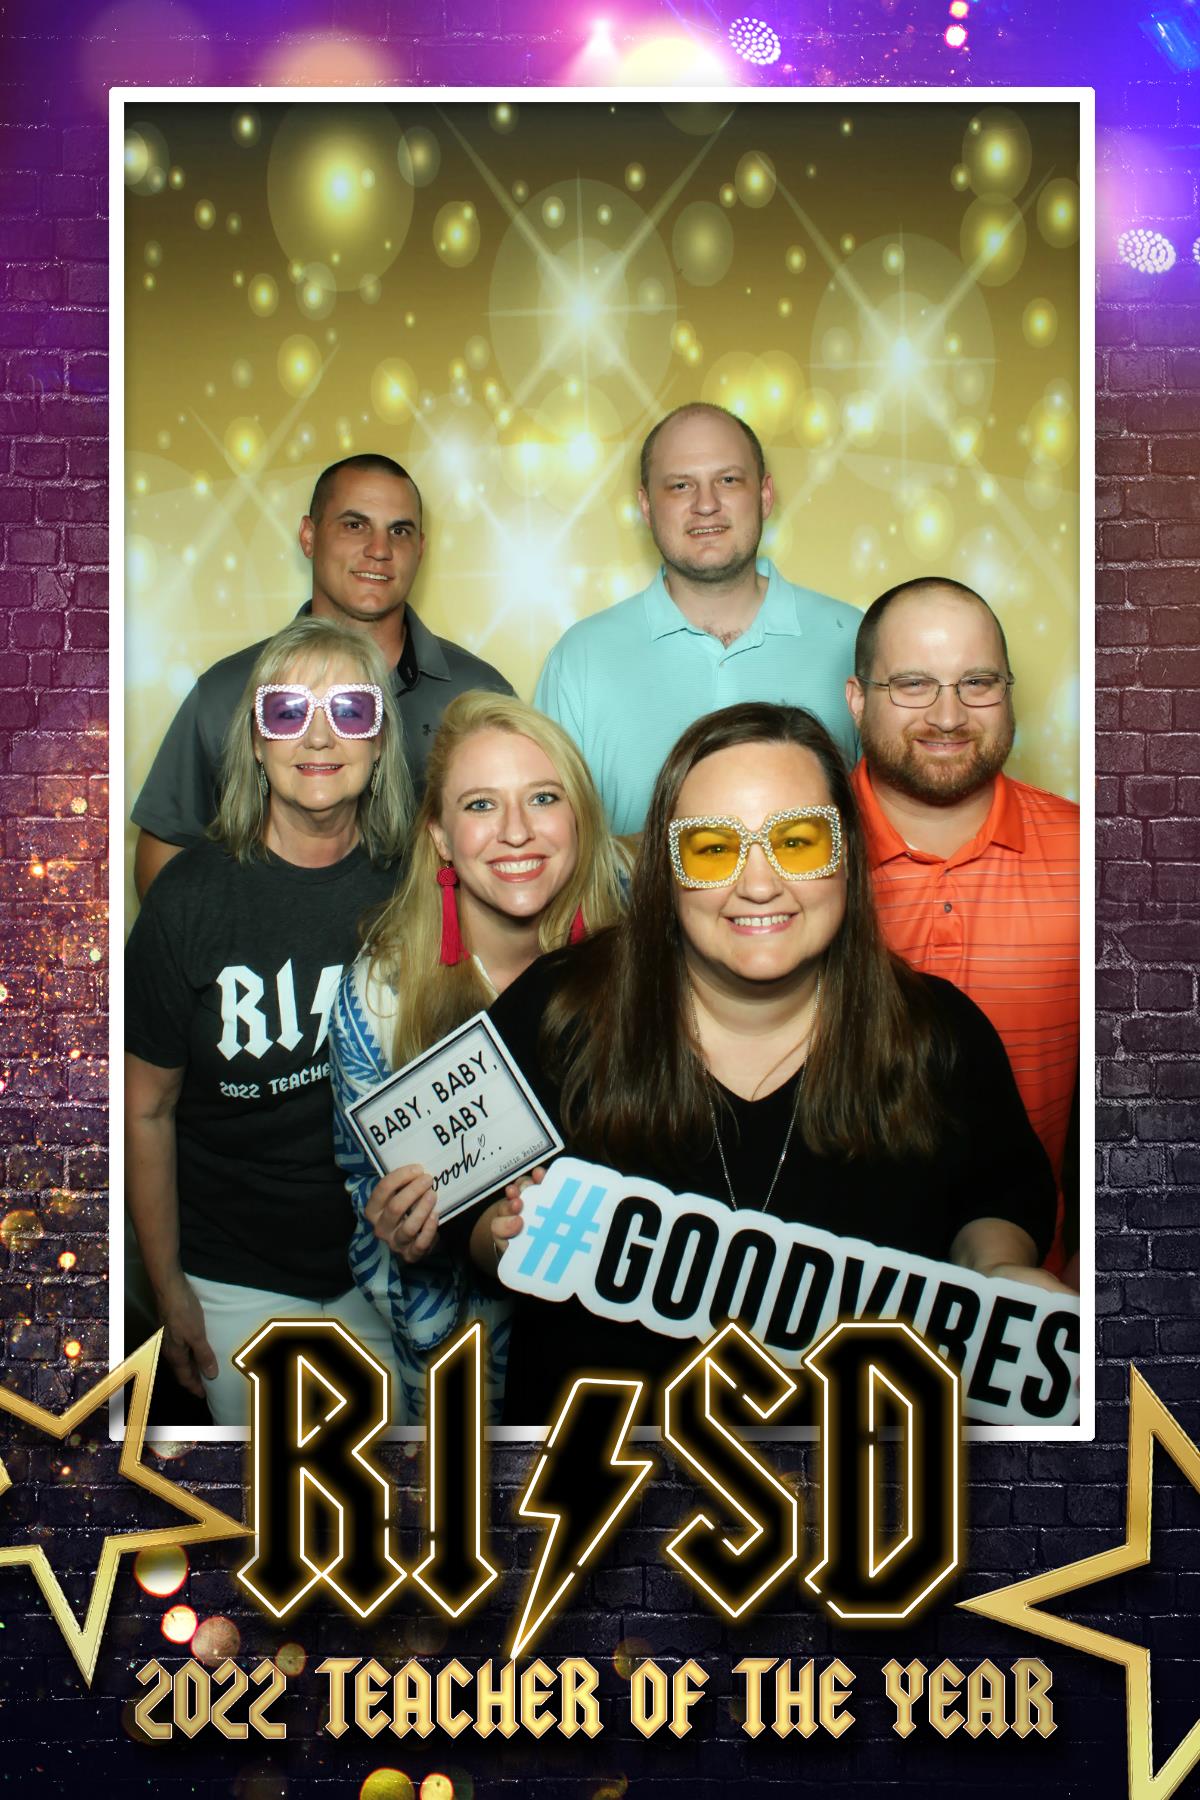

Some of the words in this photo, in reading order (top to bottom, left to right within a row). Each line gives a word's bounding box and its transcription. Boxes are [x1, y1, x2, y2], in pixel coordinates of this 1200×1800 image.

[219, 1081, 261, 1099] 2022
[267, 1061, 332, 1095] TEACHE
[369, 1096, 431, 1147] BABY,
[431, 1050, 498, 1104] BABY,
[432, 1094, 489, 1147] BABY
[517, 1176, 1080, 1419] #GOODVIBES
